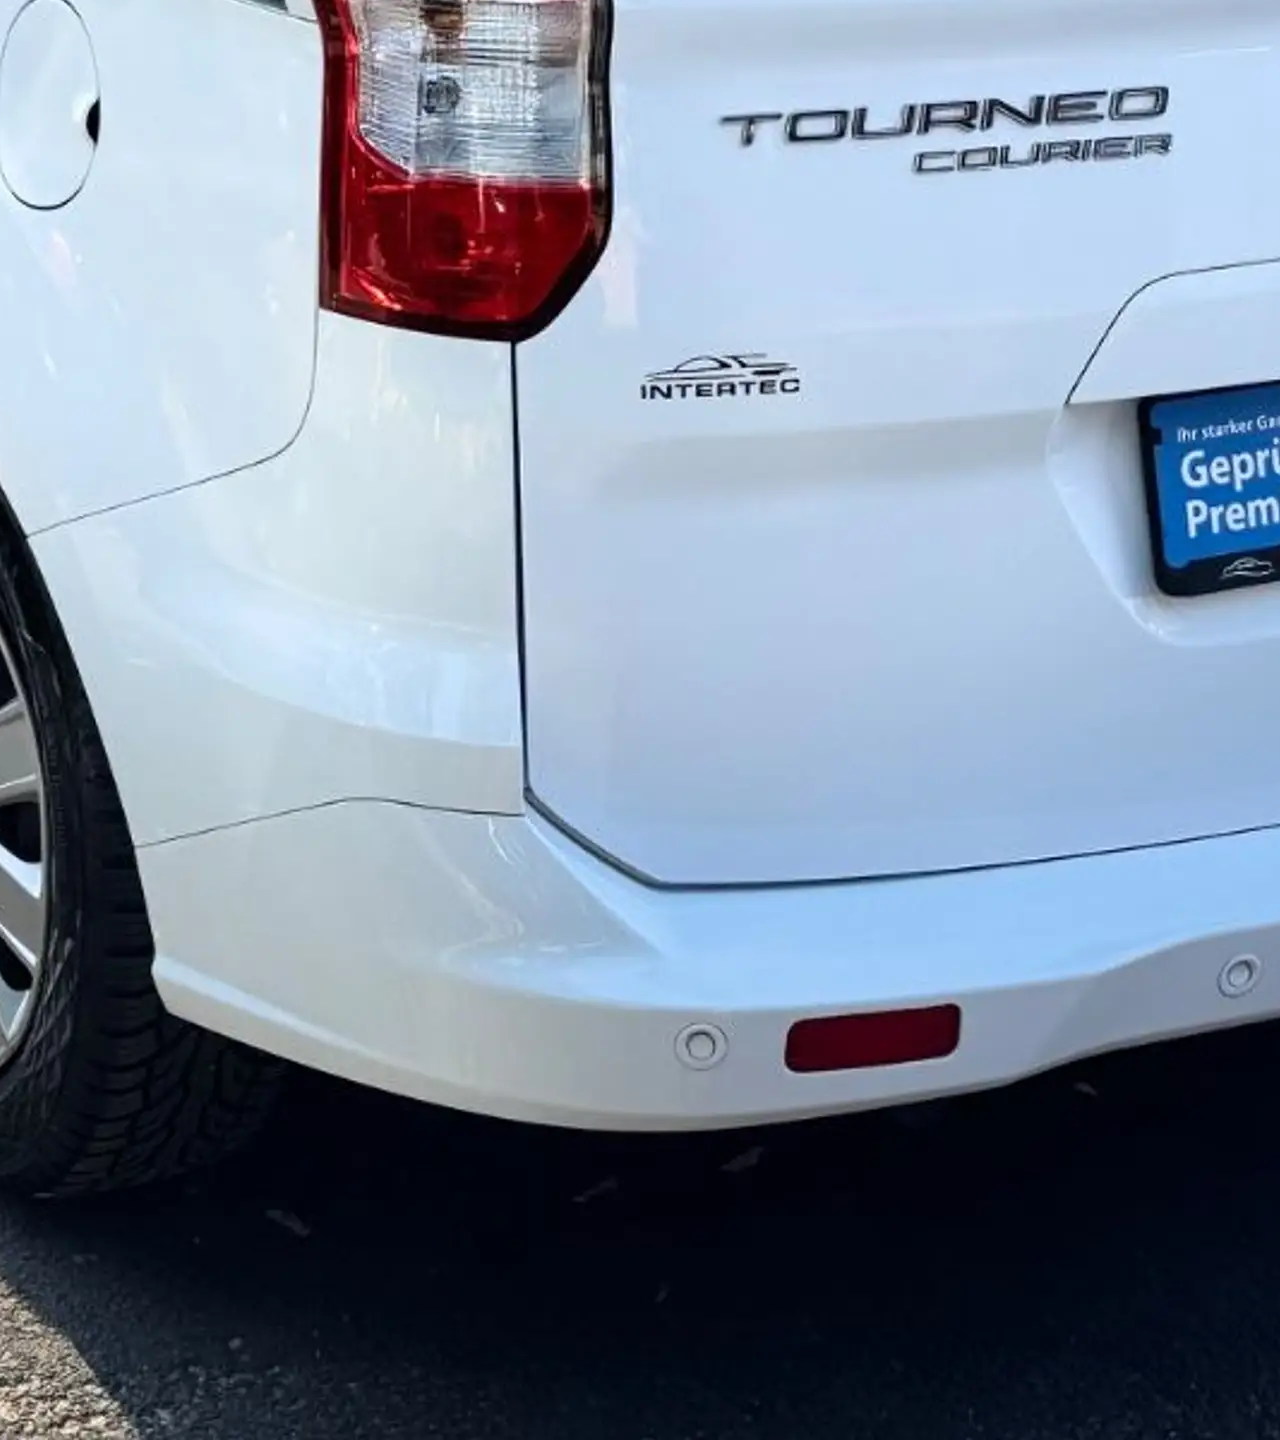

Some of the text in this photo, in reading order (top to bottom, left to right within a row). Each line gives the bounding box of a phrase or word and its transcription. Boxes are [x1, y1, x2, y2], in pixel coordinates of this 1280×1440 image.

[720, 86, 1170, 147] TOURNEO
[911, 133, 1172, 175] COURIER
[640, 378, 801, 400] INTERTEC
[1176, 426, 1197, 443] Ihr
[1201, 417, 1253, 440] starker
